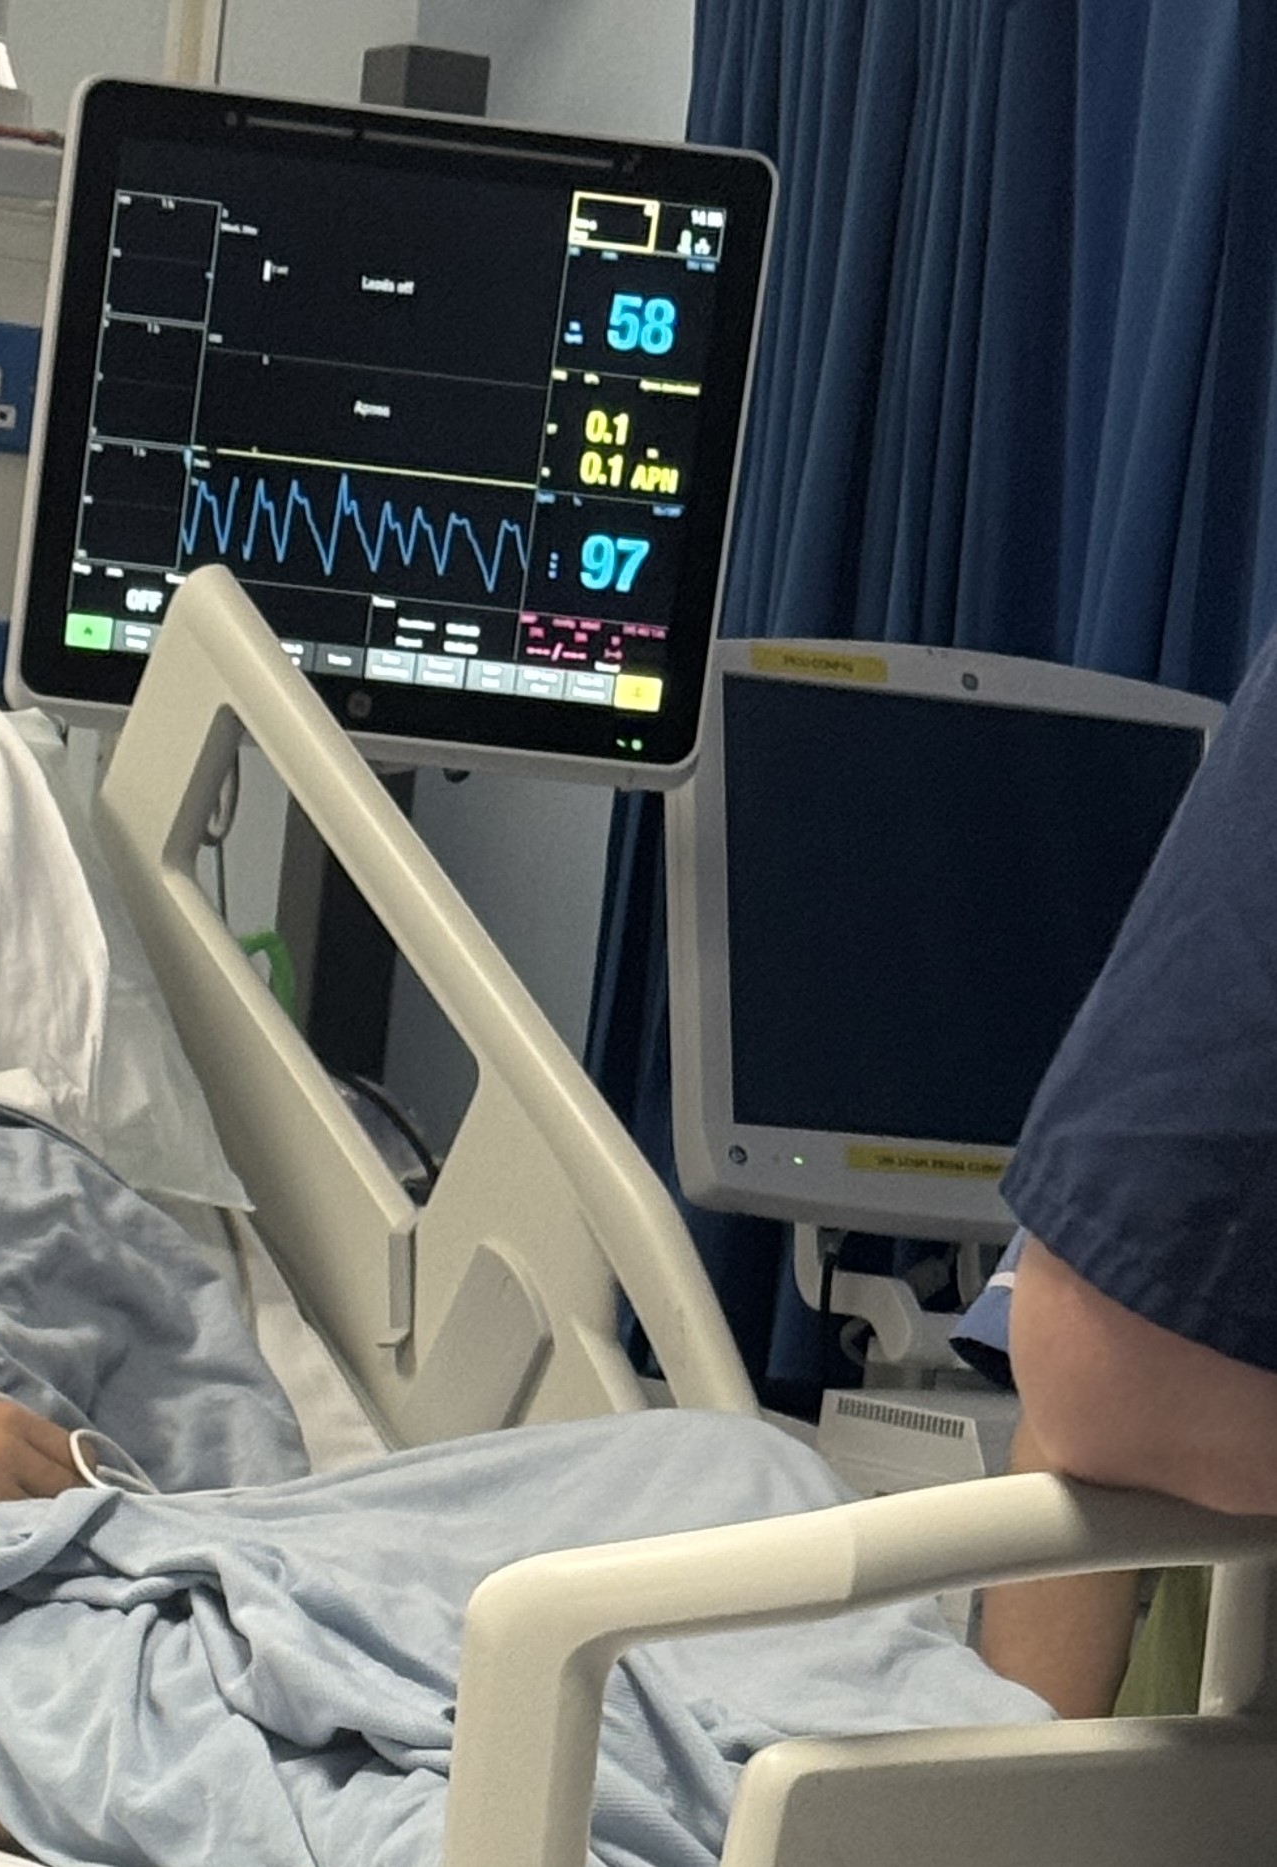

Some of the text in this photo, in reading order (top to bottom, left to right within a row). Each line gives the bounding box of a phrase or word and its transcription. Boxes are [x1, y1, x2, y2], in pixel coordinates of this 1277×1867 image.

[606, 293, 675, 355] 58
[584, 410, 629, 445] 0.1
[579, 451, 679, 494] 0.1 APN
[579, 534, 651, 592] 97
[126, 588, 163, 612] OFF
